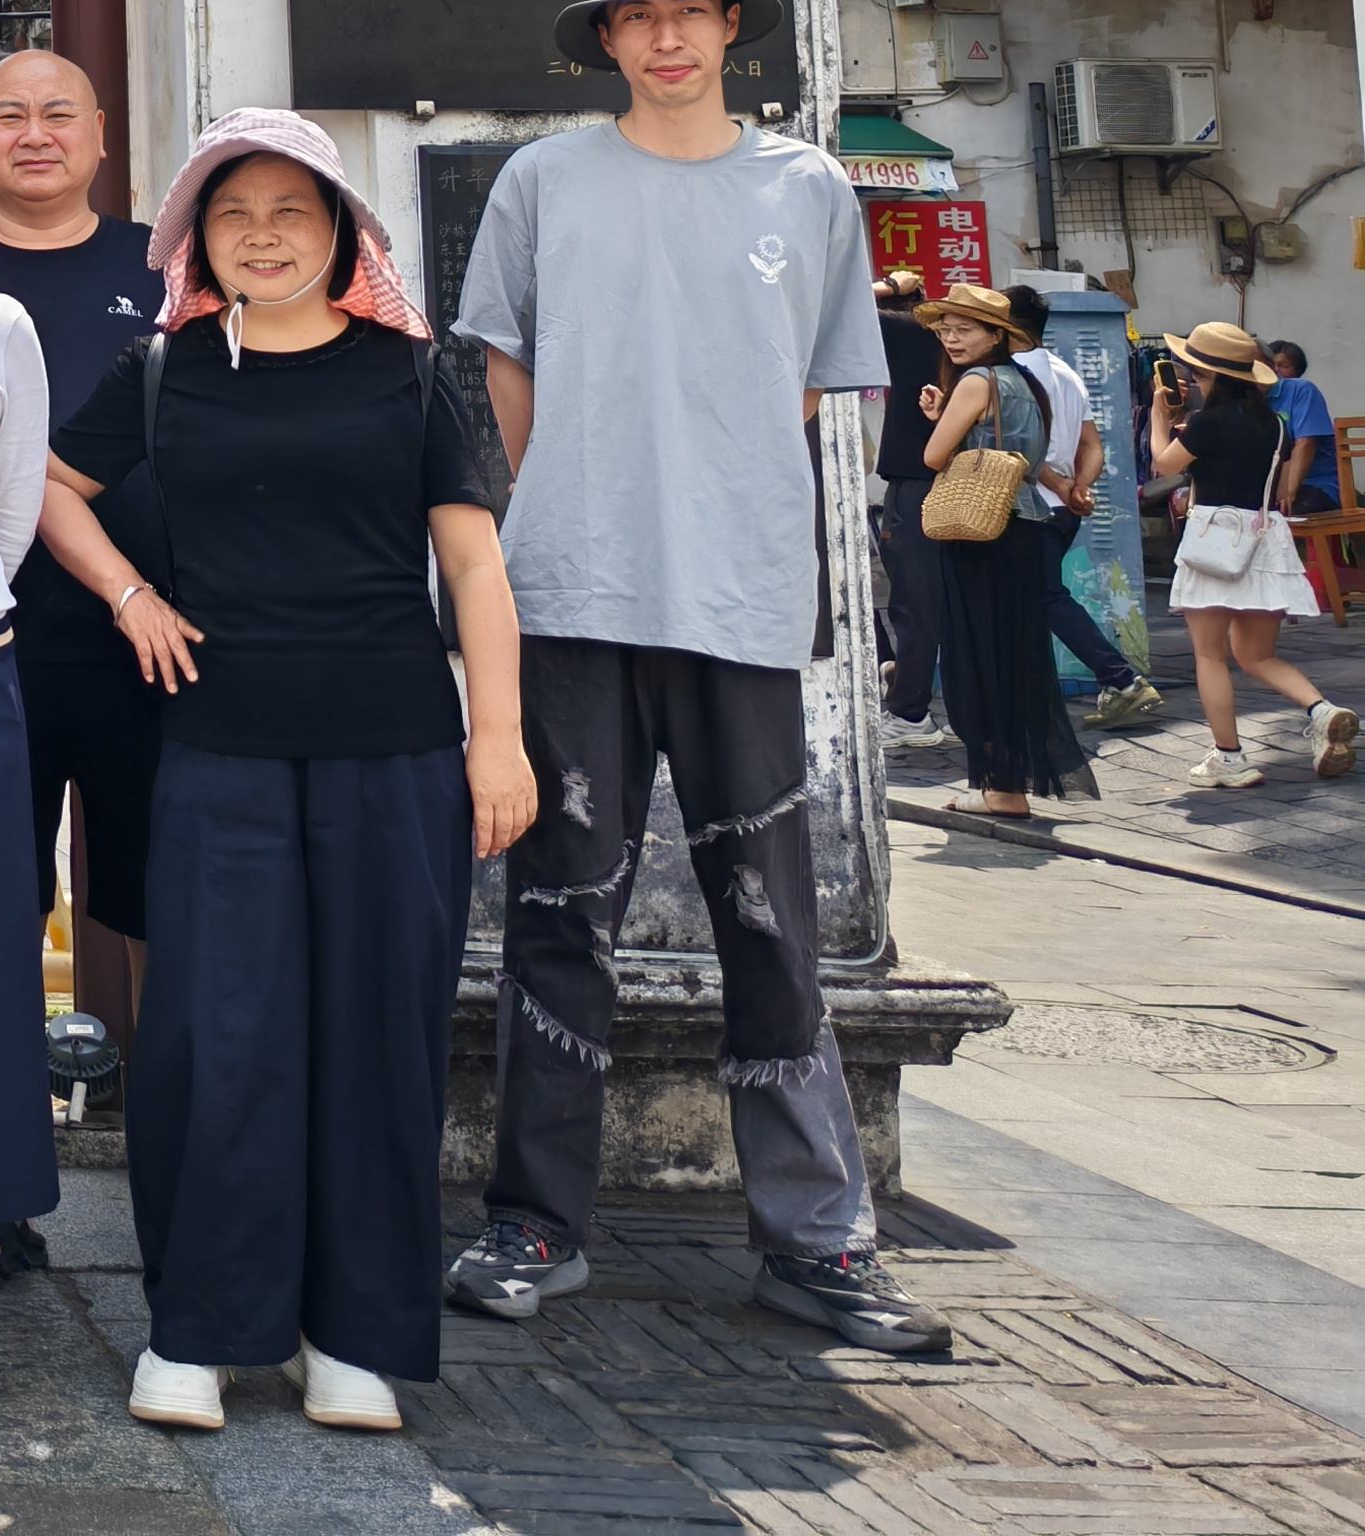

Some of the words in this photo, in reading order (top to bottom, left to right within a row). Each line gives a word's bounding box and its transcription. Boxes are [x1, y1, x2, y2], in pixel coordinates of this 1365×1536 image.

[937, 206, 983, 286] 电动车
[107, 306, 144, 318] CAMEL
